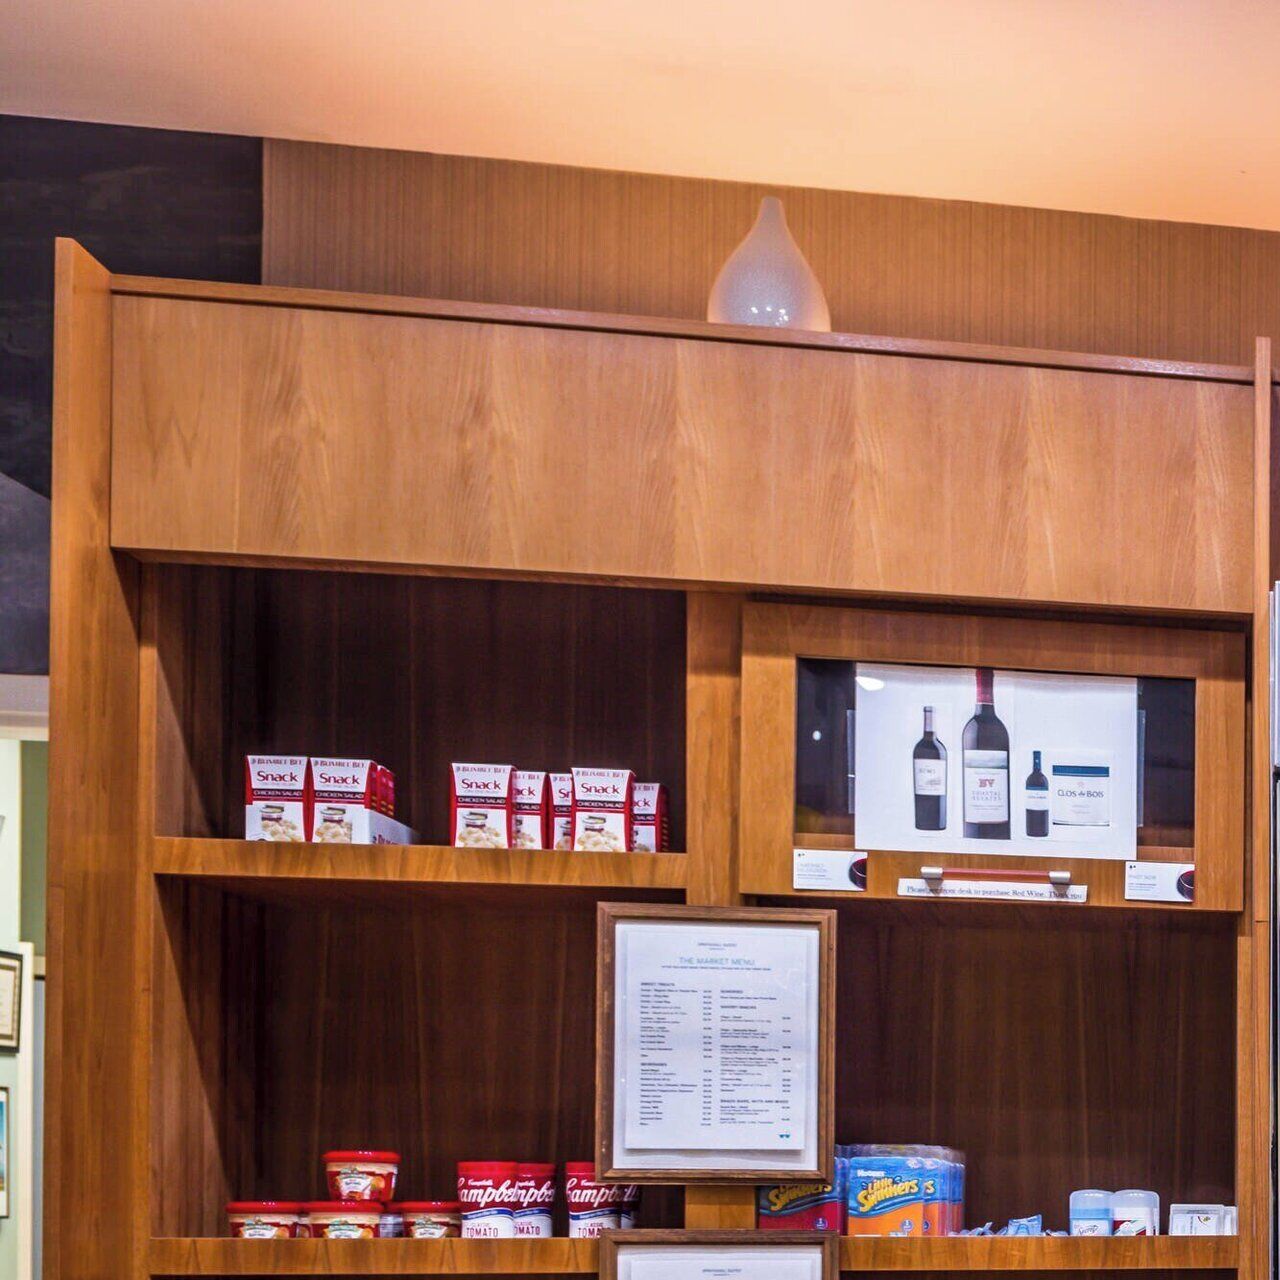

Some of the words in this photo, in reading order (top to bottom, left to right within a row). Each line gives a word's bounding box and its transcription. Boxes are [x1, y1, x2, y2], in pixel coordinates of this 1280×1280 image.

[256, 770, 299, 784] Snack
[319, 772, 361, 786] Snack
[461, 778, 501, 791] Snack
[580, 782, 620, 795] Snack
[253, 789, 279, 797] CHICKEN
[1057, 788, 1077, 798] CLOS
[1086, 789, 1105, 799] BOIS
[679, 956, 695, 965] THE
[696, 957, 729, 965] MARKET
[731, 957, 755, 966] MENU
[856, 1179, 920, 1213] Swimmers
[466, 1227, 499, 1238] TOMATO
